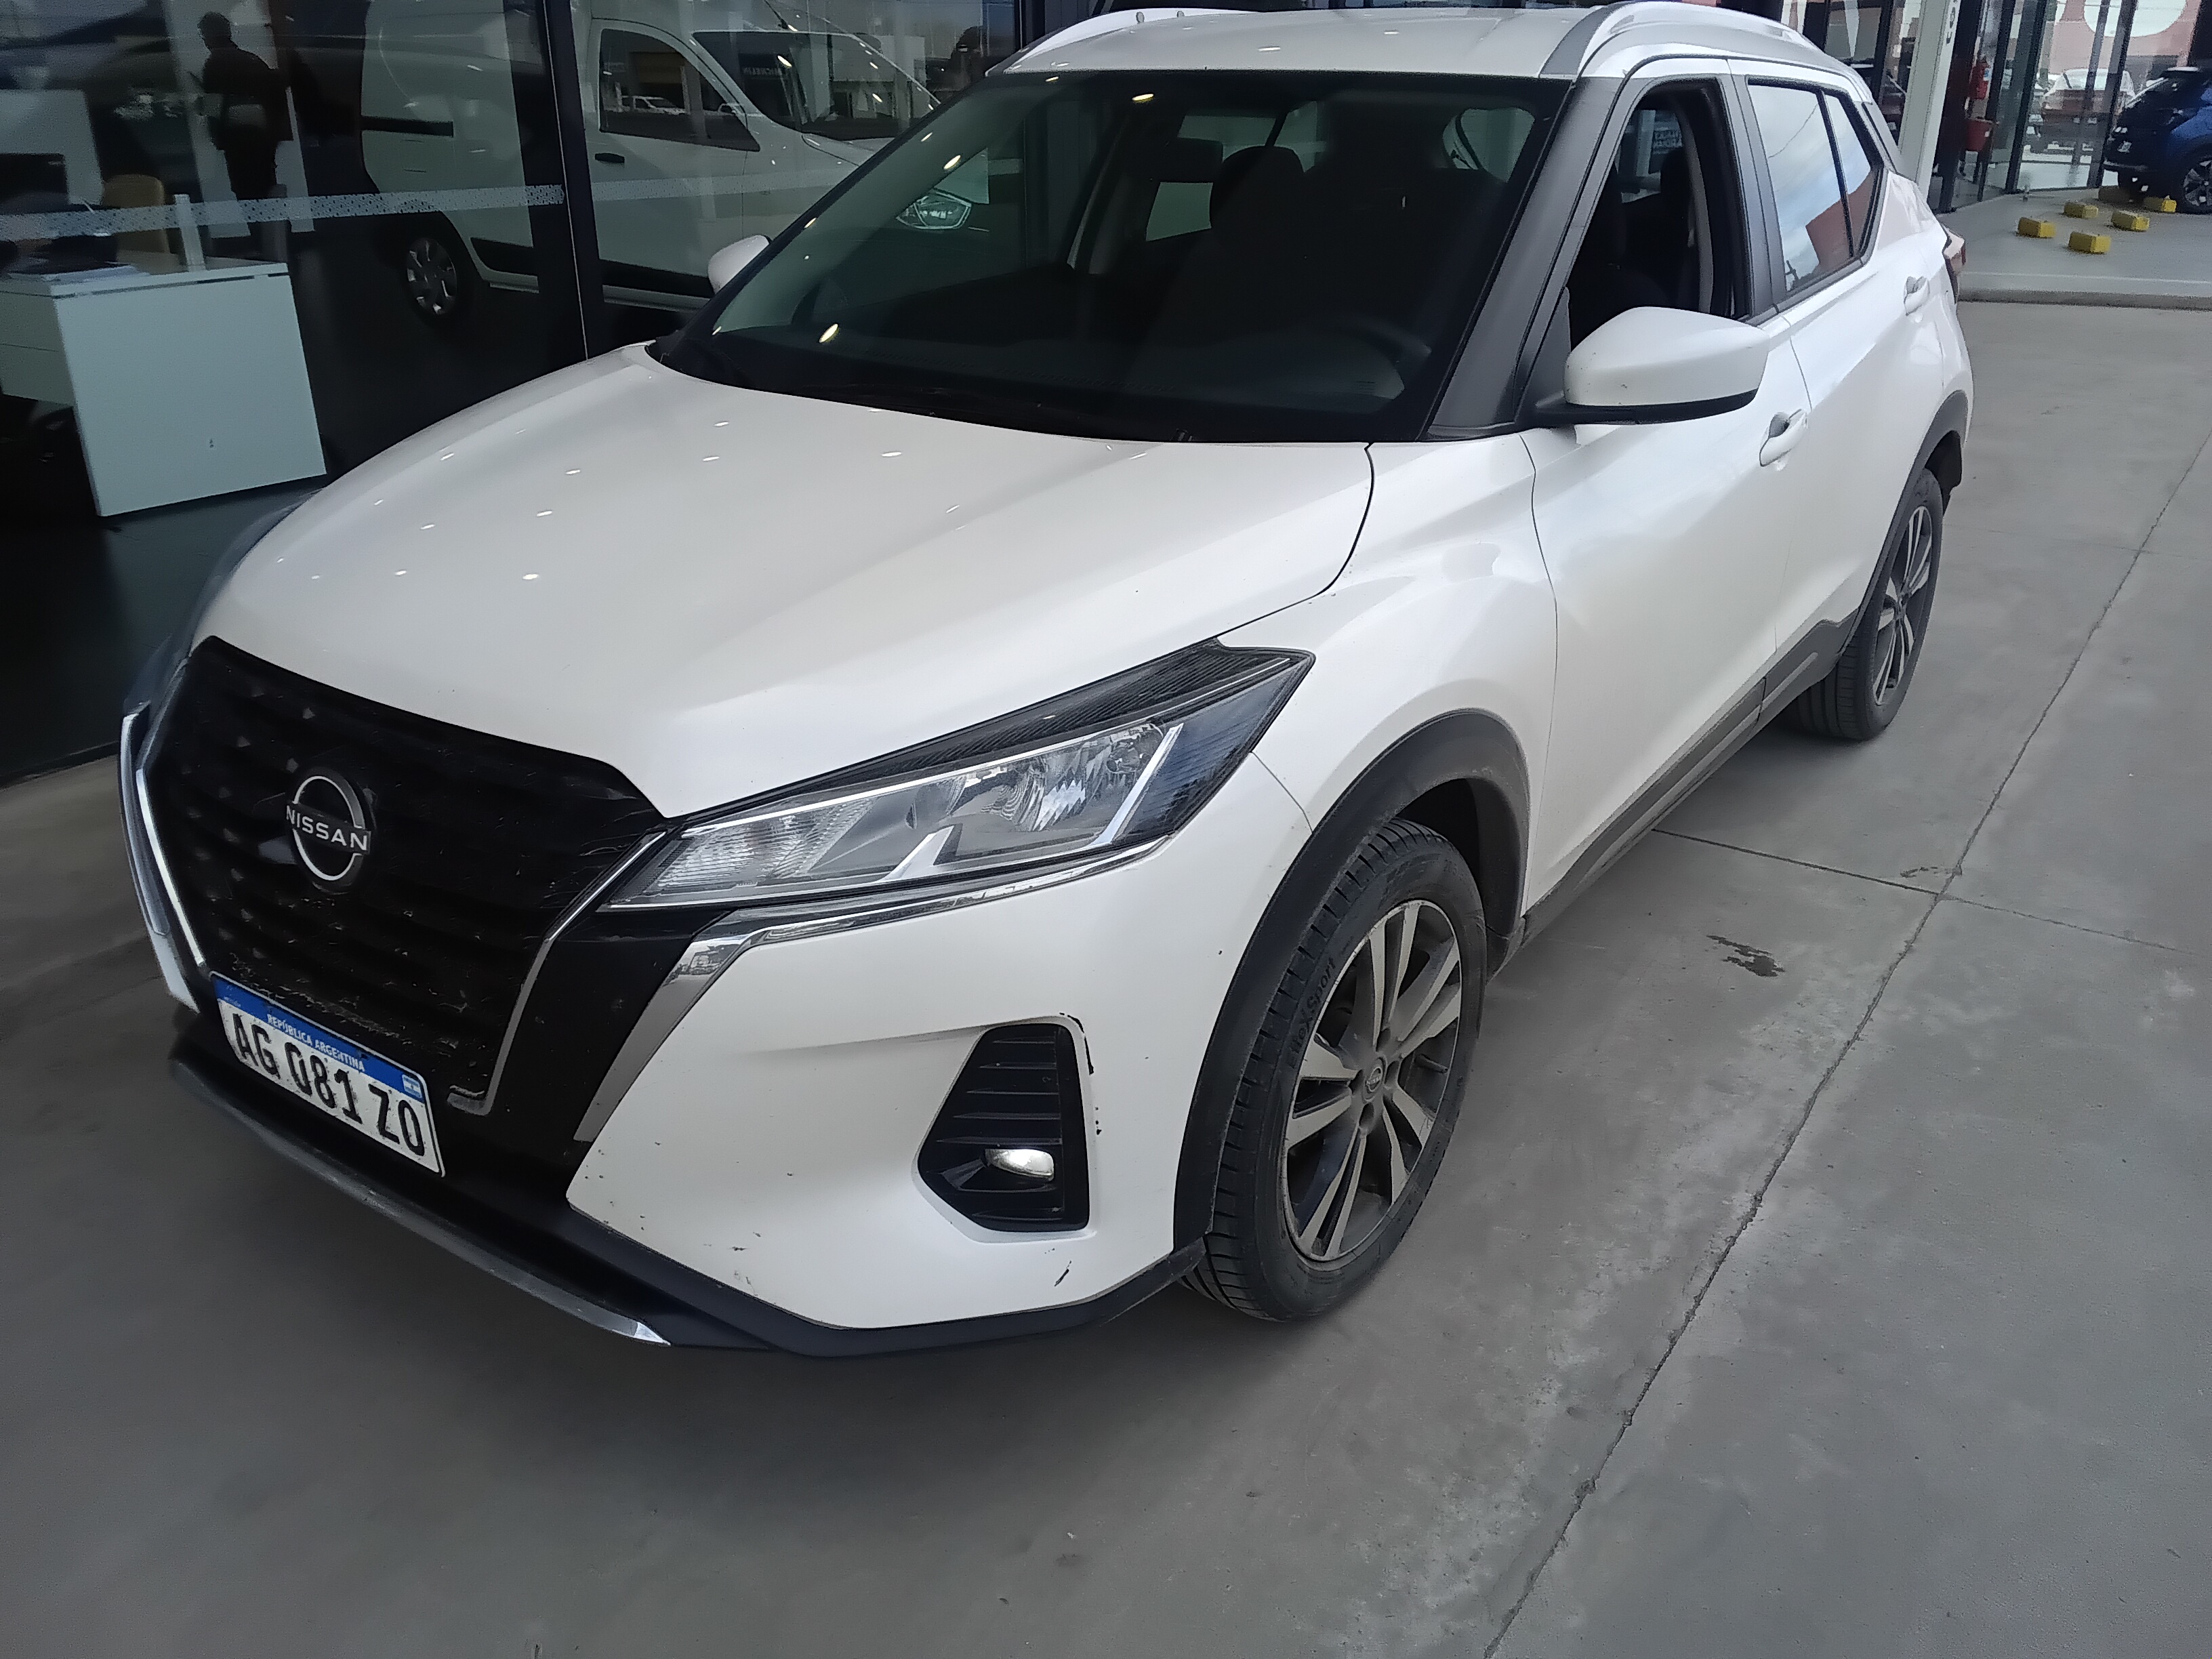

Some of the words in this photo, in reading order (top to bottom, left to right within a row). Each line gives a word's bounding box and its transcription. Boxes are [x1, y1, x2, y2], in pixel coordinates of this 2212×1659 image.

[286, 805, 367, 851] NISSAN
[232, 1013, 281, 1080] AG
[285, 1042, 363, 1124] 081
[267, 1014, 313, 1046] REPÚBLICA
[315, 1039, 365, 1072] ARGENTINA
